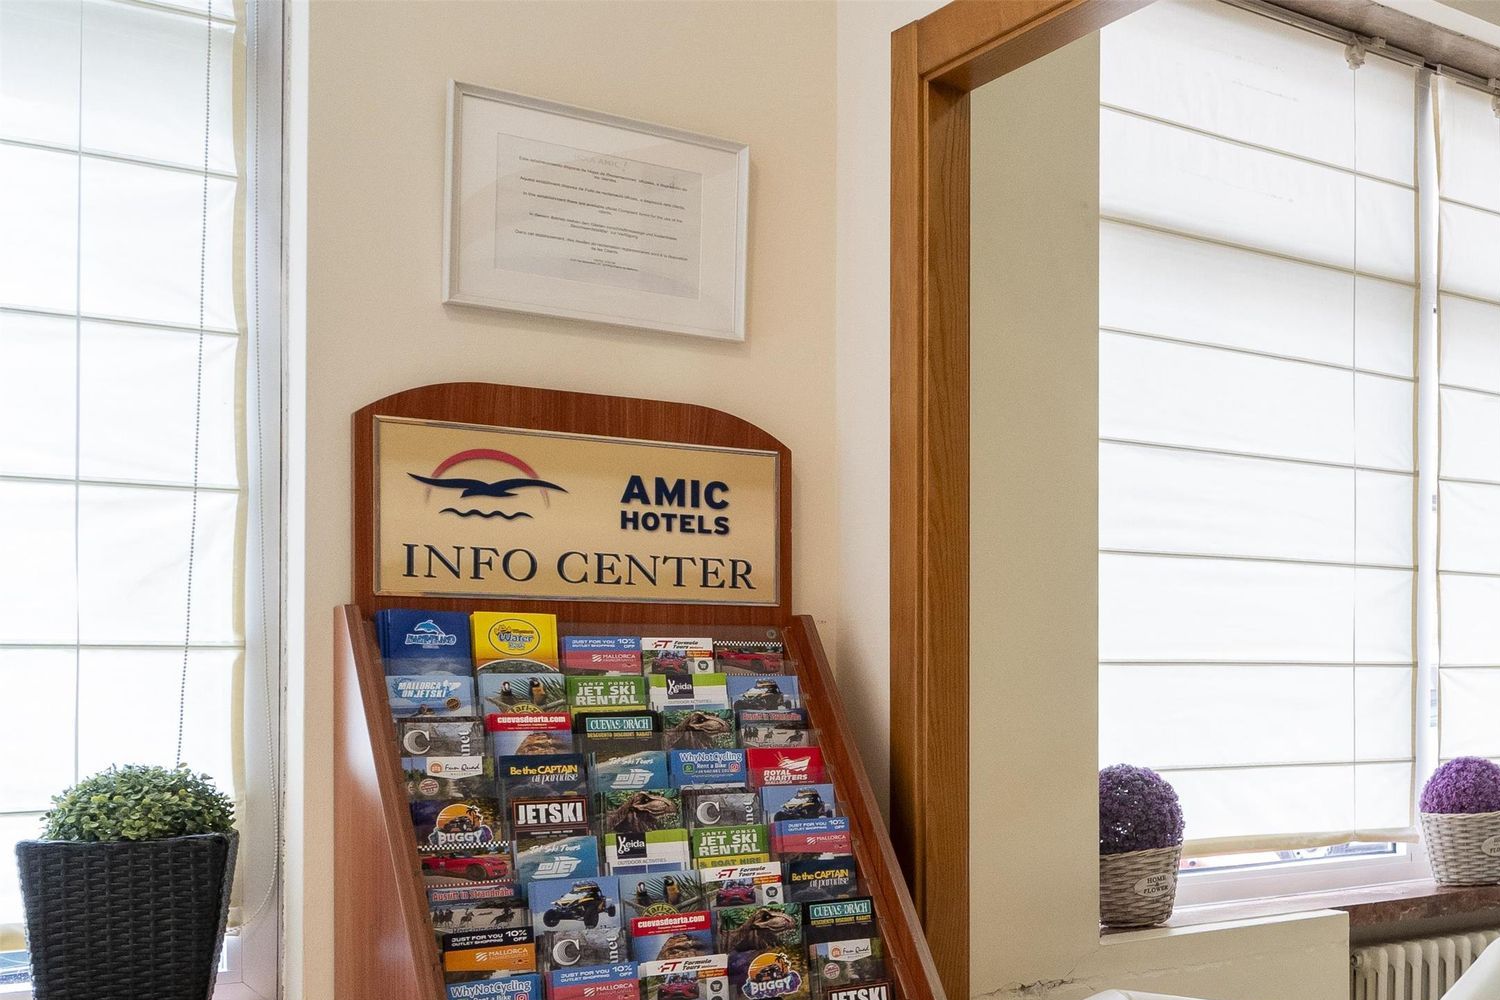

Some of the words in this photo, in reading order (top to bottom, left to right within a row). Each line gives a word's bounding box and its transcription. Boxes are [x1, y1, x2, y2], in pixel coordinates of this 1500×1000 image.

[620, 474, 730, 510] AMIC
[620, 511, 730, 535] HOTELS
[402, 543, 538, 582] INFO
[557, 549, 757, 590] CENTER
[398, 680, 441, 691] MALLORCA
[577, 687, 602, 696] JET
[610, 686, 635, 695] SKI
[402, 690, 413, 698] ON
[414, 688, 446, 698] JETSKI
[575, 695, 638, 705] RENTAL
[590, 719, 620, 730] CUEVAS
[623, 718, 649, 729] DRACH
[679, 751, 742, 763] WhyNotCycling
[510, 767, 522, 775] Be
[523, 766, 537, 775] the
[537, 765, 577, 774] CAPTAIN
[517, 802, 583, 825] JETSKI
[438, 831, 482, 844] BUGGY
[700, 835, 729, 847] JET
[732, 833, 758, 845] SKI
[698, 844, 761, 857] RENTAL
[711, 859, 737, 867] BOAT
[740, 857, 762, 865] HIRE
[792, 874, 801, 882] Be
[801, 872, 814, 881] the
[814, 869, 849, 878] CAPTAIN
[1147, 875, 1166, 884] HOME
[1143, 885, 1168, 894] FLOWER
[814, 905, 841, 917] CUEVAS
[844, 902, 868, 914] DRACH
[638, 915, 705, 928] cuevasdearta.com
[489, 948, 528, 957] MALLORCA
[612, 965, 632, 973] 10%
[450, 980, 531, 998] WhyNotCycling
[596, 983, 633, 991] MALLORCA
[751, 978, 791, 995] BUGGY
